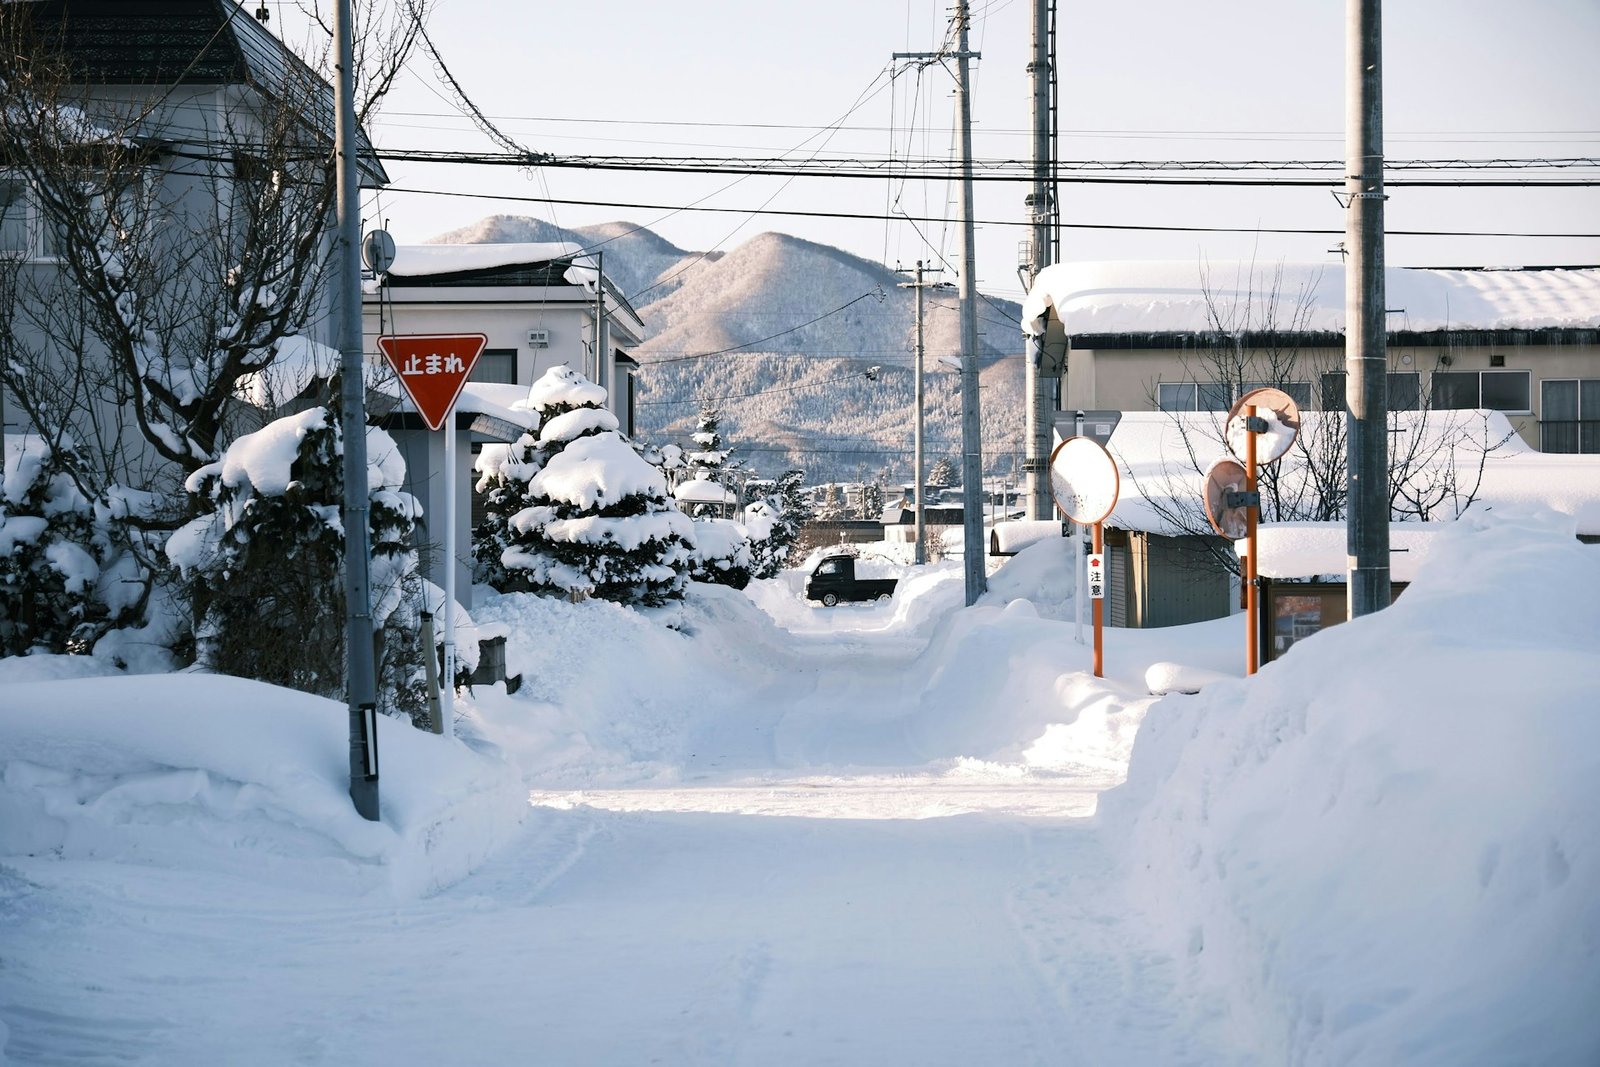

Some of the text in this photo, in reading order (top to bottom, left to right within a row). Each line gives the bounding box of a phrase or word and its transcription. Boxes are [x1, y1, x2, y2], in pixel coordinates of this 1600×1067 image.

[402, 353, 465, 375] 止まれ
[1090, 571, 1102, 596] 注意
